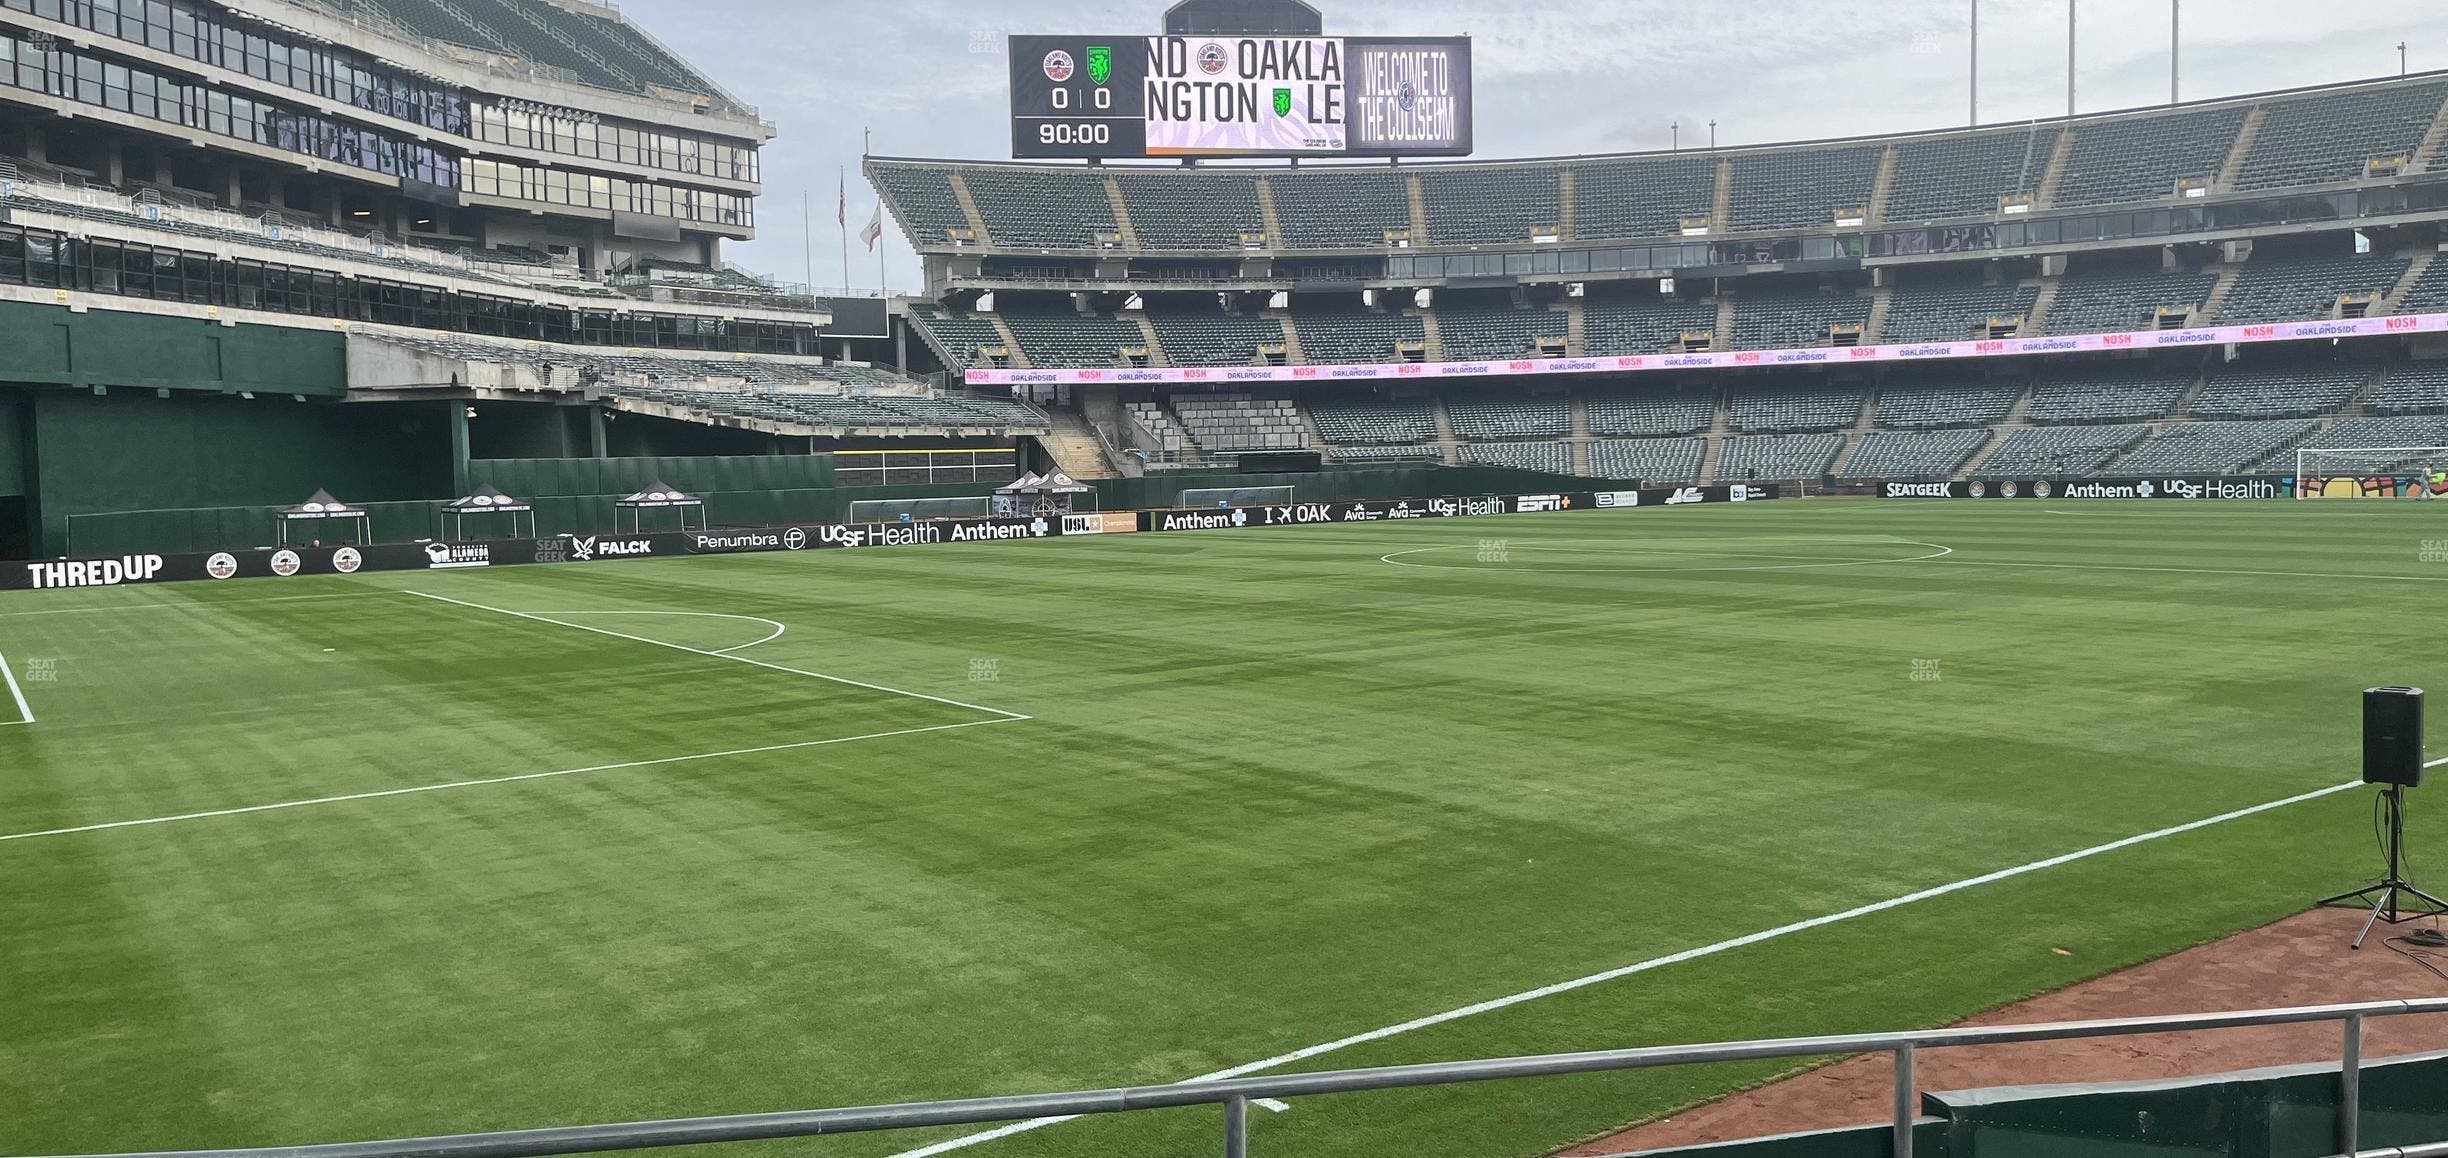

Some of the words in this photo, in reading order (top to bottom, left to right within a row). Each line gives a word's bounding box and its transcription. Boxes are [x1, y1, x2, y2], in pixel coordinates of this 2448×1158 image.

[1144, 37, 1187, 78] ND
[1238, 39, 1342, 81] OAKLA
[1363, 52, 1429, 96] WELCOME
[1431, 52, 1448, 96] TO
[1052, 88, 1068, 109] 0
[1094, 88, 1111, 109] 0
[1148, 81, 1258, 123] NGTON
[1307, 84, 1346, 124] LE
[1359, 97, 1384, 141] THE
[1387, 96, 1455, 141] COLISEUM
[1040, 124, 1109, 144] 90:00
[2386, 317, 2417, 328] NOSH
[2243, 326, 2274, 336] NOSH
[2295, 325, 2357, 336] OAKLANDSIDE
[2103, 335, 2131, 344] NOSH
[2158, 333, 2216, 343] OAKLANDSIDE
[1975, 340, 2003, 350] NOSH
[2022, 341, 2076, 350] OAKLANDSIDE
[1850, 348, 1876, 357] NOSH
[1899, 347, 1951, 356] OAKLANDSIDE
[1618, 357, 1642, 366] NOSH
[1664, 357, 1712, 366] OAKLANDSIDE
[1735, 353, 1760, 362] NOSH
[1777, 353, 1827, 361] OAKLANDSIDE
[1398, 365, 1421, 374] NOSH
[1442, 366, 1488, 374] OAKLANDSIDE
[1510, 362, 1533, 370] NOSH
[1549, 362, 1597, 370] OAKLANDSIDE
[966, 371, 989, 380] NOSH
[1079, 370, 1101, 379] NOSH
[1183, 369, 1207, 378] NOSH
[1293, 367, 1316, 376] NOSH
[1332, 369, 1377, 377] OAKLANDSIDE
[1011, 374, 1057, 382] OAKLANDSIDE
[1117, 373, 1162, 381] OAKLANDSIDE
[1886, 482, 1951, 498] SEATGEEK
[2063, 482, 2134, 498] Anthem
[2163, 480, 2203, 499] UCSF
[2205, 480, 2275, 499] Health
[1428, 498, 1457, 517] UCSF
[1459, 496, 1505, 516] Health
[1264, 507, 1273, 524] I
[1296, 504, 1332, 522] OAK
[1344, 509, 1365, 520] Ava
[1387, 507, 1409, 519] Ava
[1064, 517, 1090, 532] USL
[1163, 511, 1229, 531] Anthem
[820, 525, 864, 547] UCSF
[868, 522, 940, 546] Health
[950, 521, 1028, 541] Anthem
[697, 533, 778, 549] Penumbra
[599, 540, 651, 555] FALCK
[27, 554, 163, 589] THREDUP
